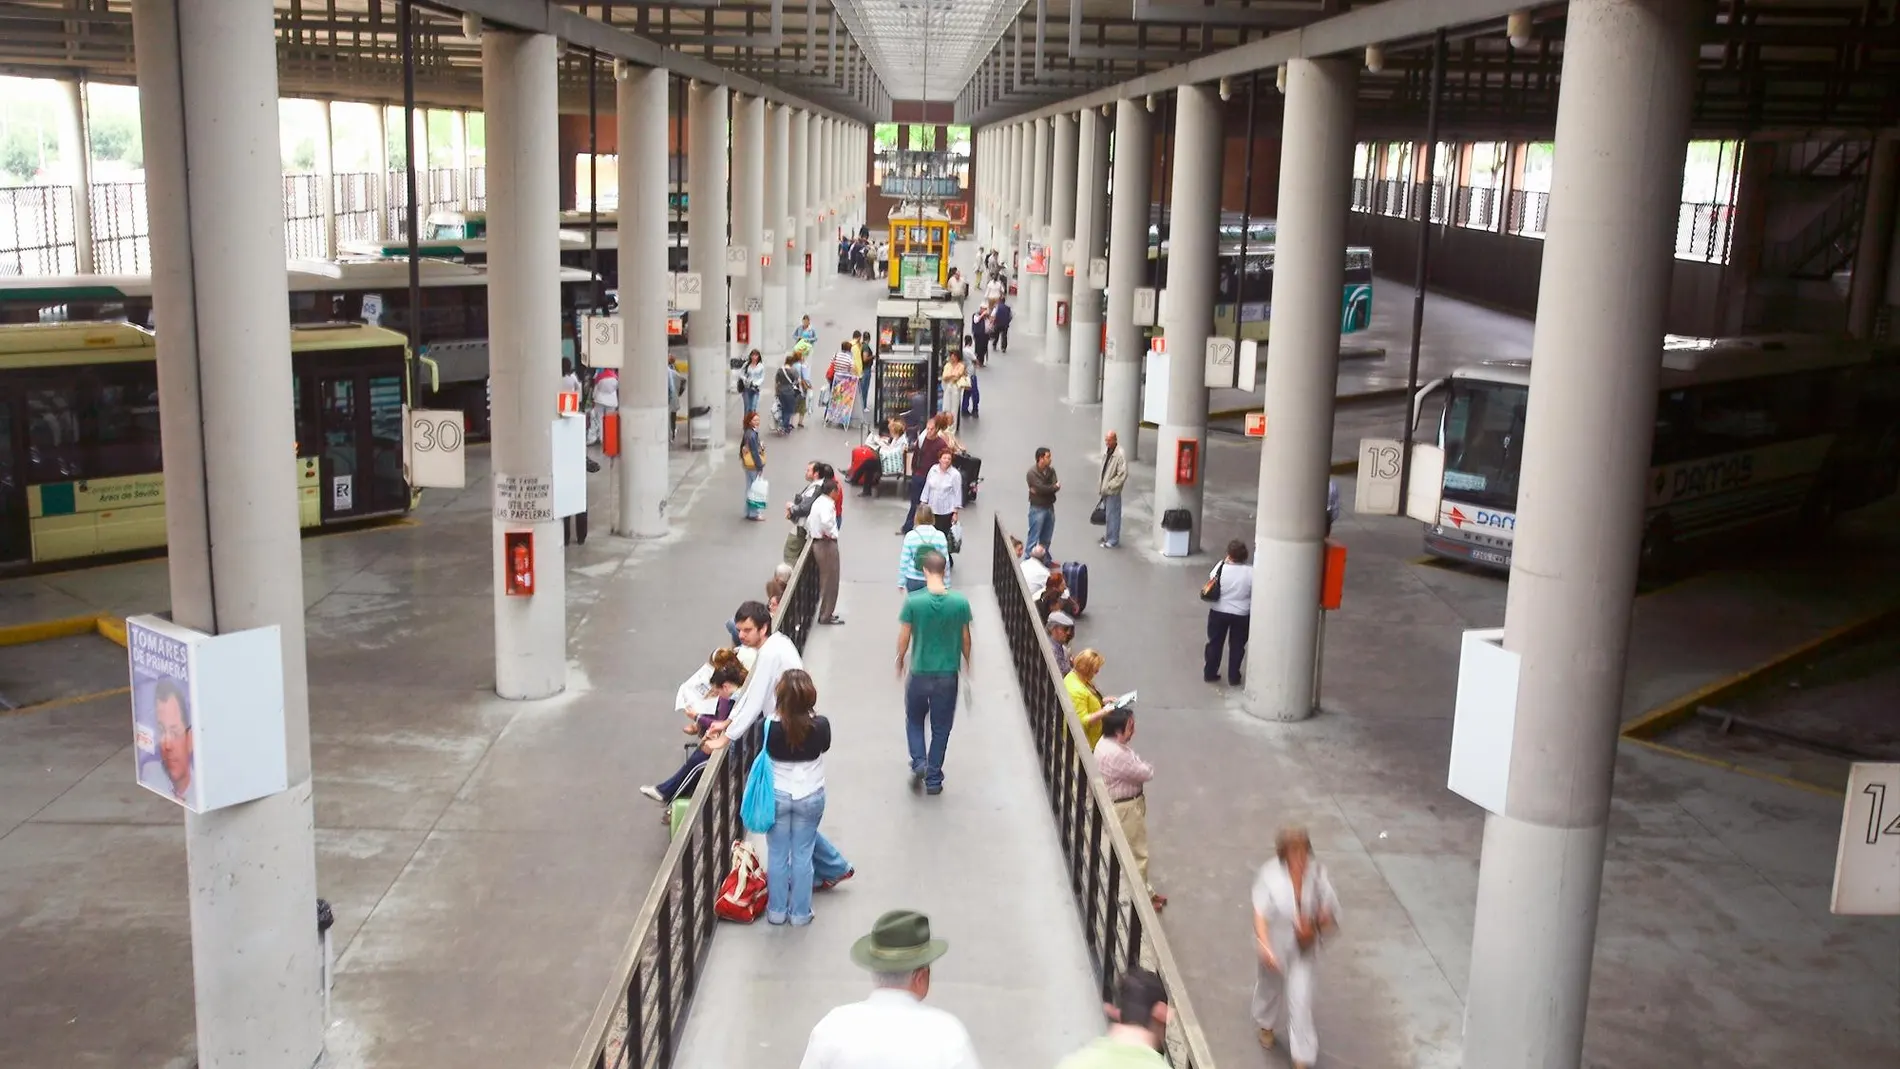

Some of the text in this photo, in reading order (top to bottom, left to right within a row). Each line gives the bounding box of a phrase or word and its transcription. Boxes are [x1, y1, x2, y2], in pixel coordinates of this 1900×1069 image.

[678, 276, 700, 295] 32
[595, 321, 619, 345] 31
[1210, 343, 1233, 366] 12
[413, 418, 462, 453] 30
[1367, 446, 1401, 480] 13
[134, 489, 160, 499] Sevilla
[508, 500, 536, 510] UTILICE
[510, 509, 551, 519] PAPELERAS
[131, 625, 188, 664] TOMARES
[133, 646, 145, 666] DE
[145, 652, 189, 683] PRIMERA
